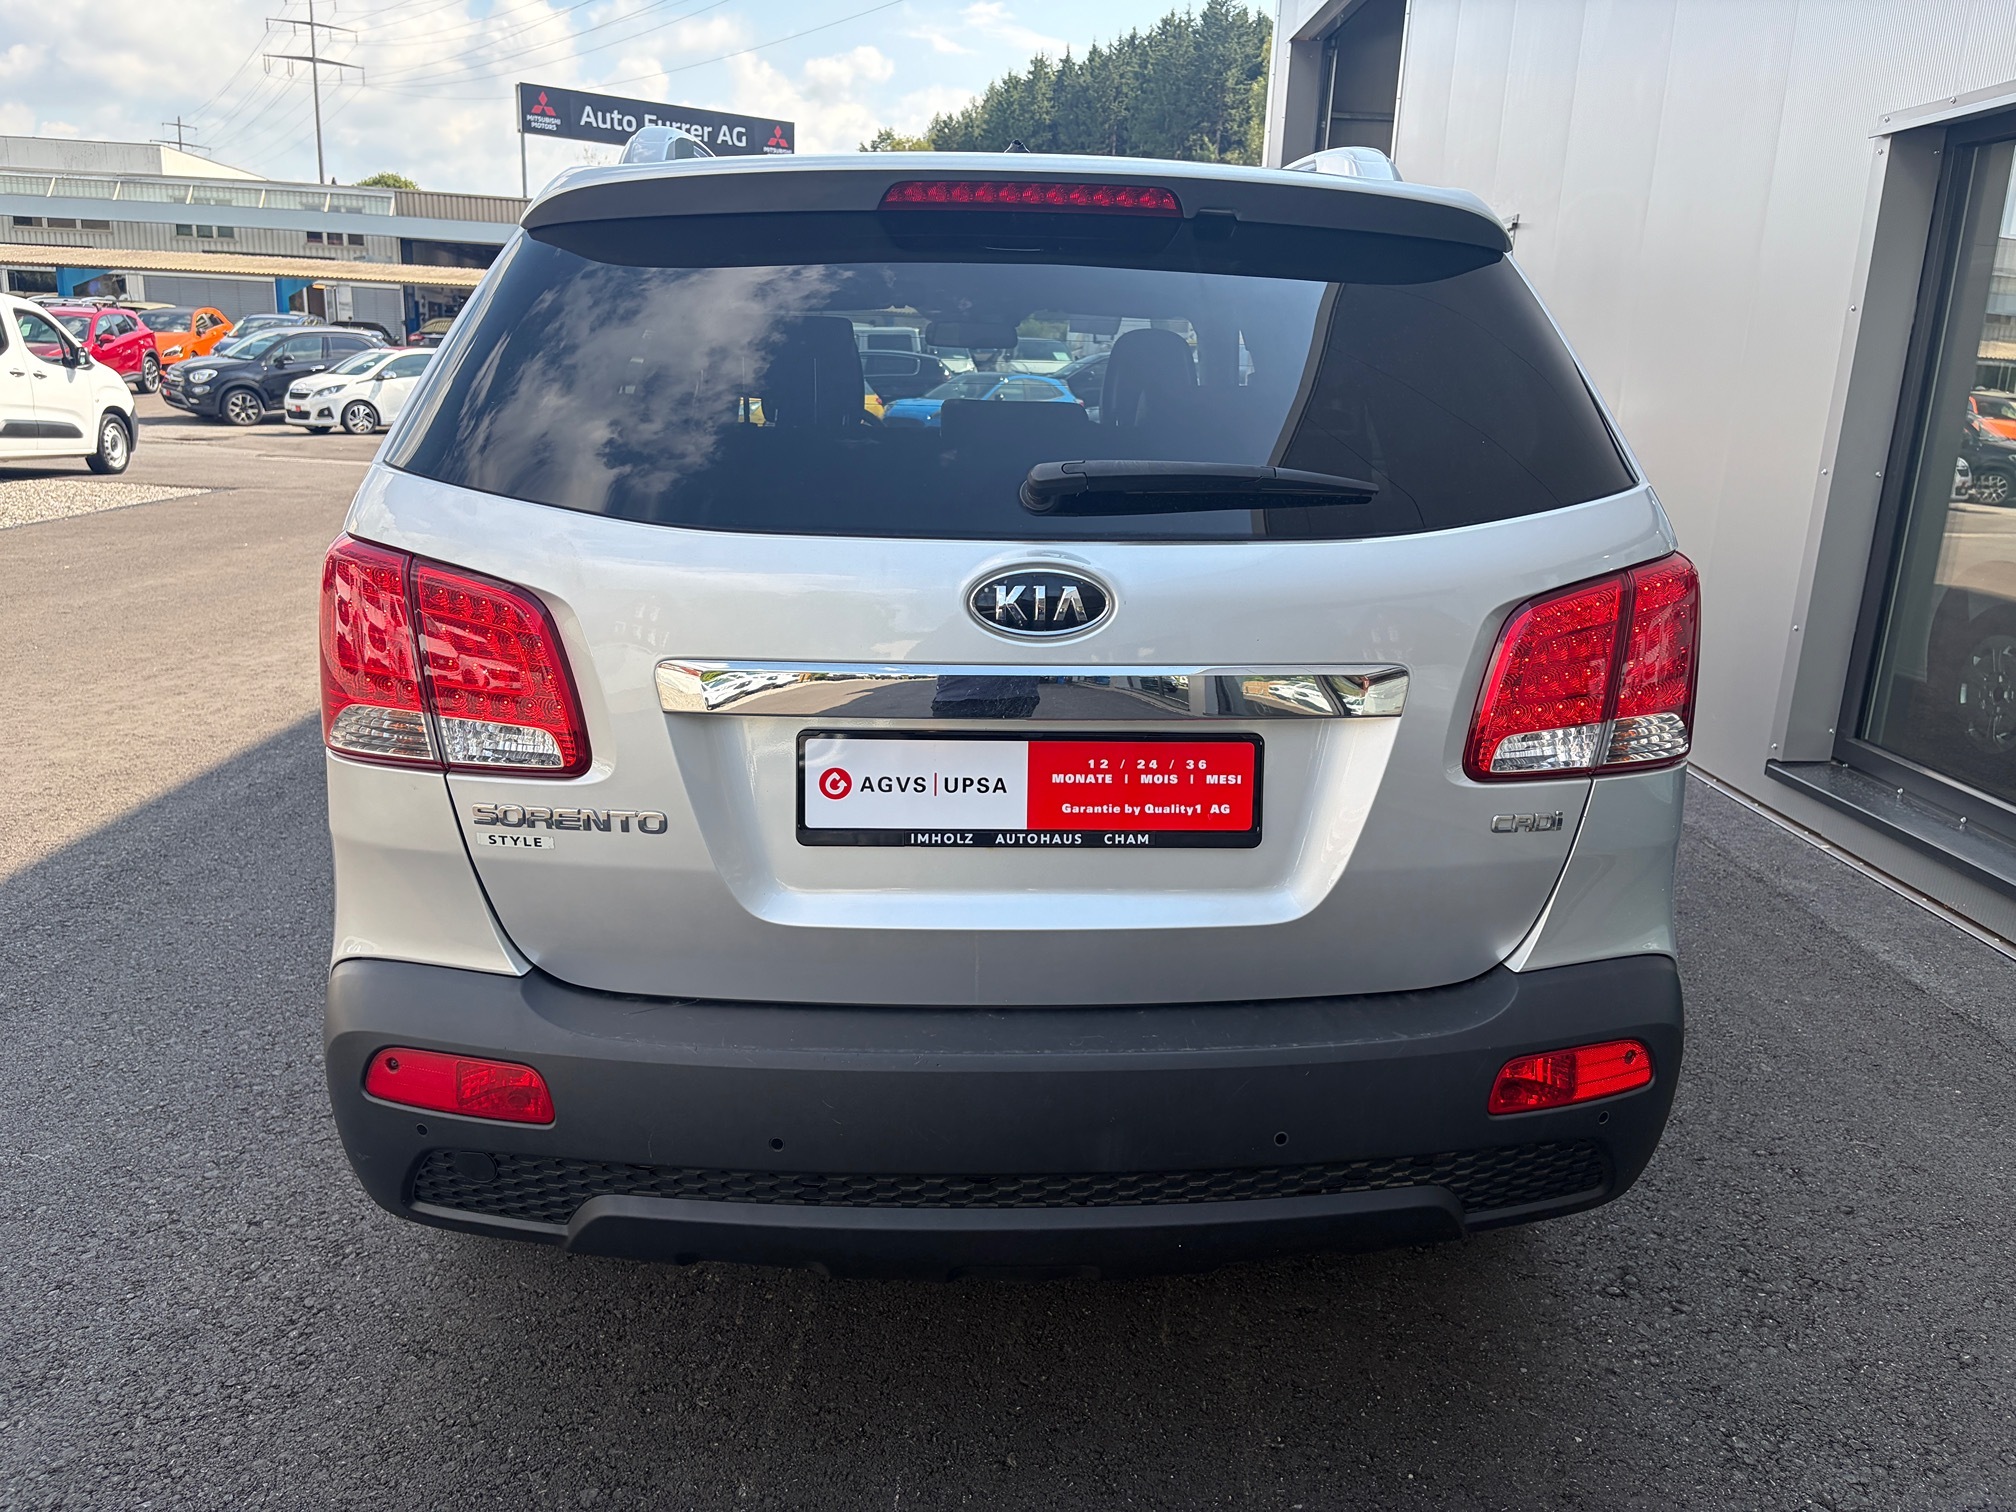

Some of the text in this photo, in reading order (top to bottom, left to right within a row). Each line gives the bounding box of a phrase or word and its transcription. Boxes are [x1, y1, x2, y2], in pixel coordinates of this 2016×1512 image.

[531, 121, 557, 130] MOTORS
[580, 105, 637, 132] Auto
[717, 125, 747, 147] AG
[993, 585, 1088, 621] KIA
[1088, 759, 1109, 769] 12
[1136, 759, 1158, 769] 24
[1186, 760, 1207, 770] 36
[860, 776, 1008, 794] AGVS UPSA
[1051, 774, 1113, 784] MONATE
[1140, 774, 1179, 784] MOIS
[1206, 774, 1242, 785] MESI
[1061, 803, 1231, 816] Garantie by Quality1 AG
[472, 803, 668, 834] SORENTO
[1491, 810, 1563, 833] CRDi
[488, 834, 543, 848] STYLE
[910, 833, 1150, 845] IMHOLZ AUTOHAUS CHAM
